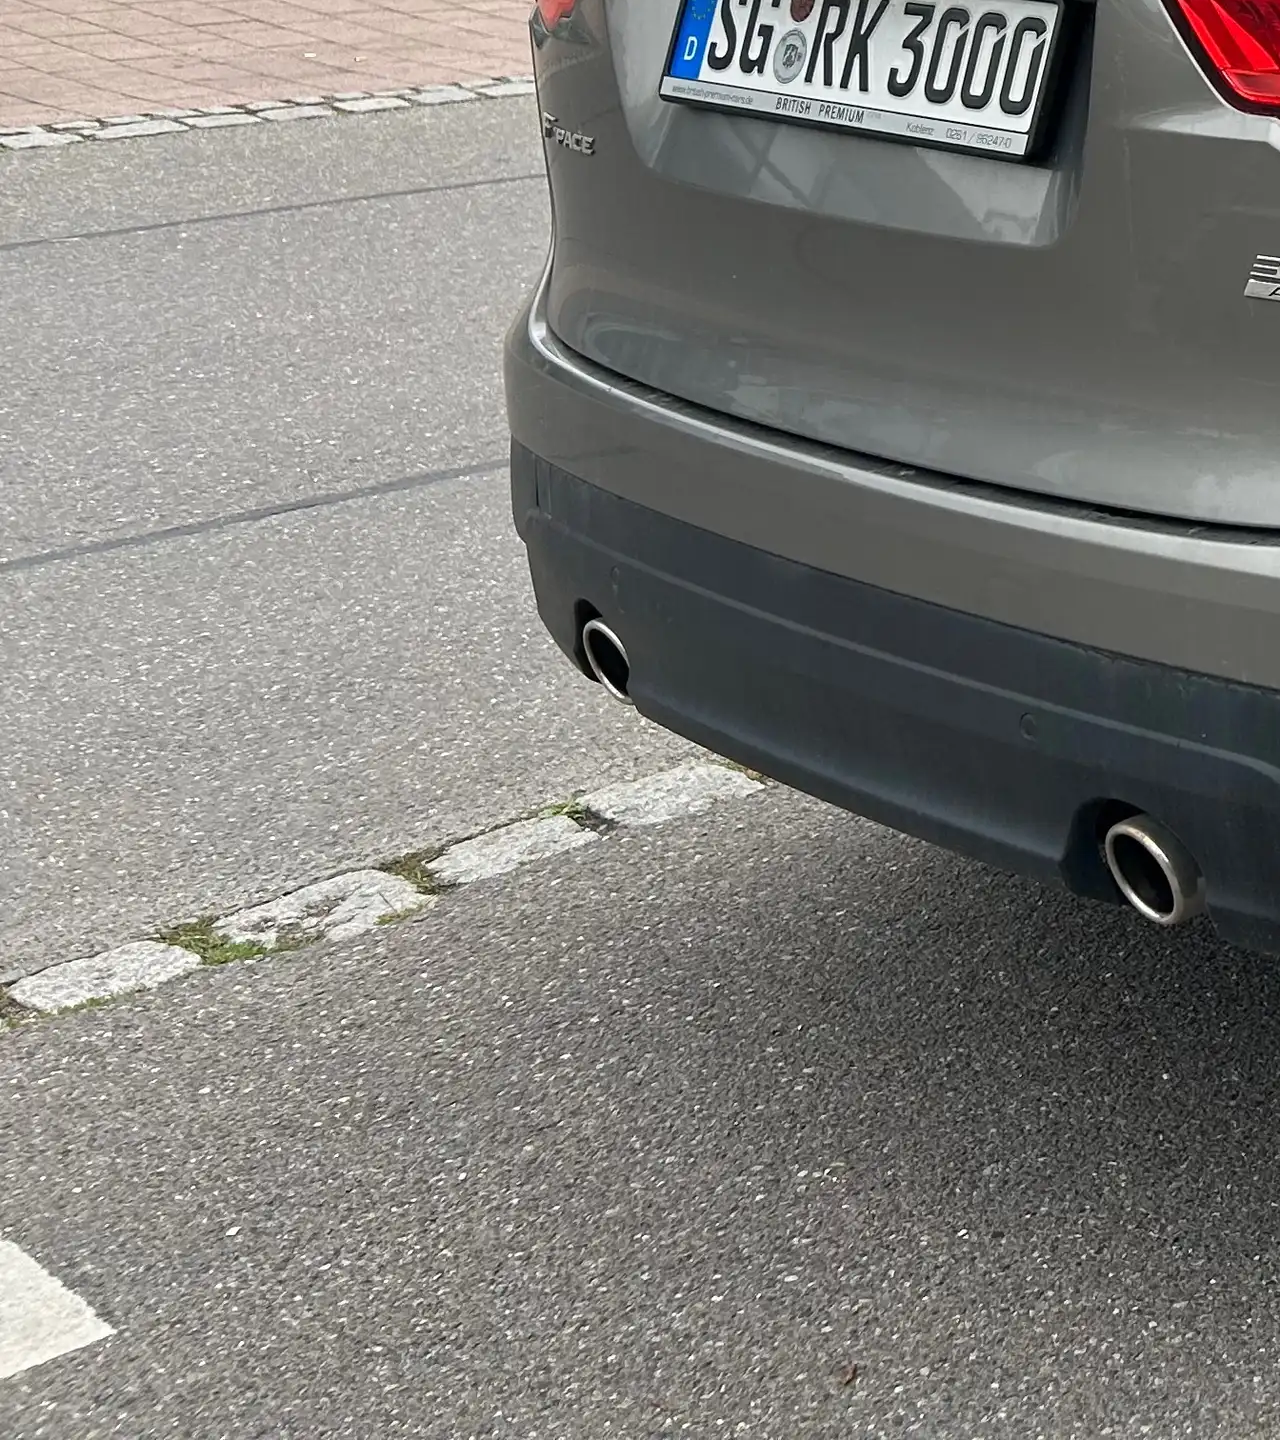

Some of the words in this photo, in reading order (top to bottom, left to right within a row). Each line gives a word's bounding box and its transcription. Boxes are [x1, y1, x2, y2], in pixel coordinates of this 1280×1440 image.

[683, 35, 698, 61] D
[887, 1, 1047, 116] 3000
[775, 97, 812, 115] BRITISH
[818, 103, 865, 124] PREMIUM
[906, 122, 935, 136] Koblenz
